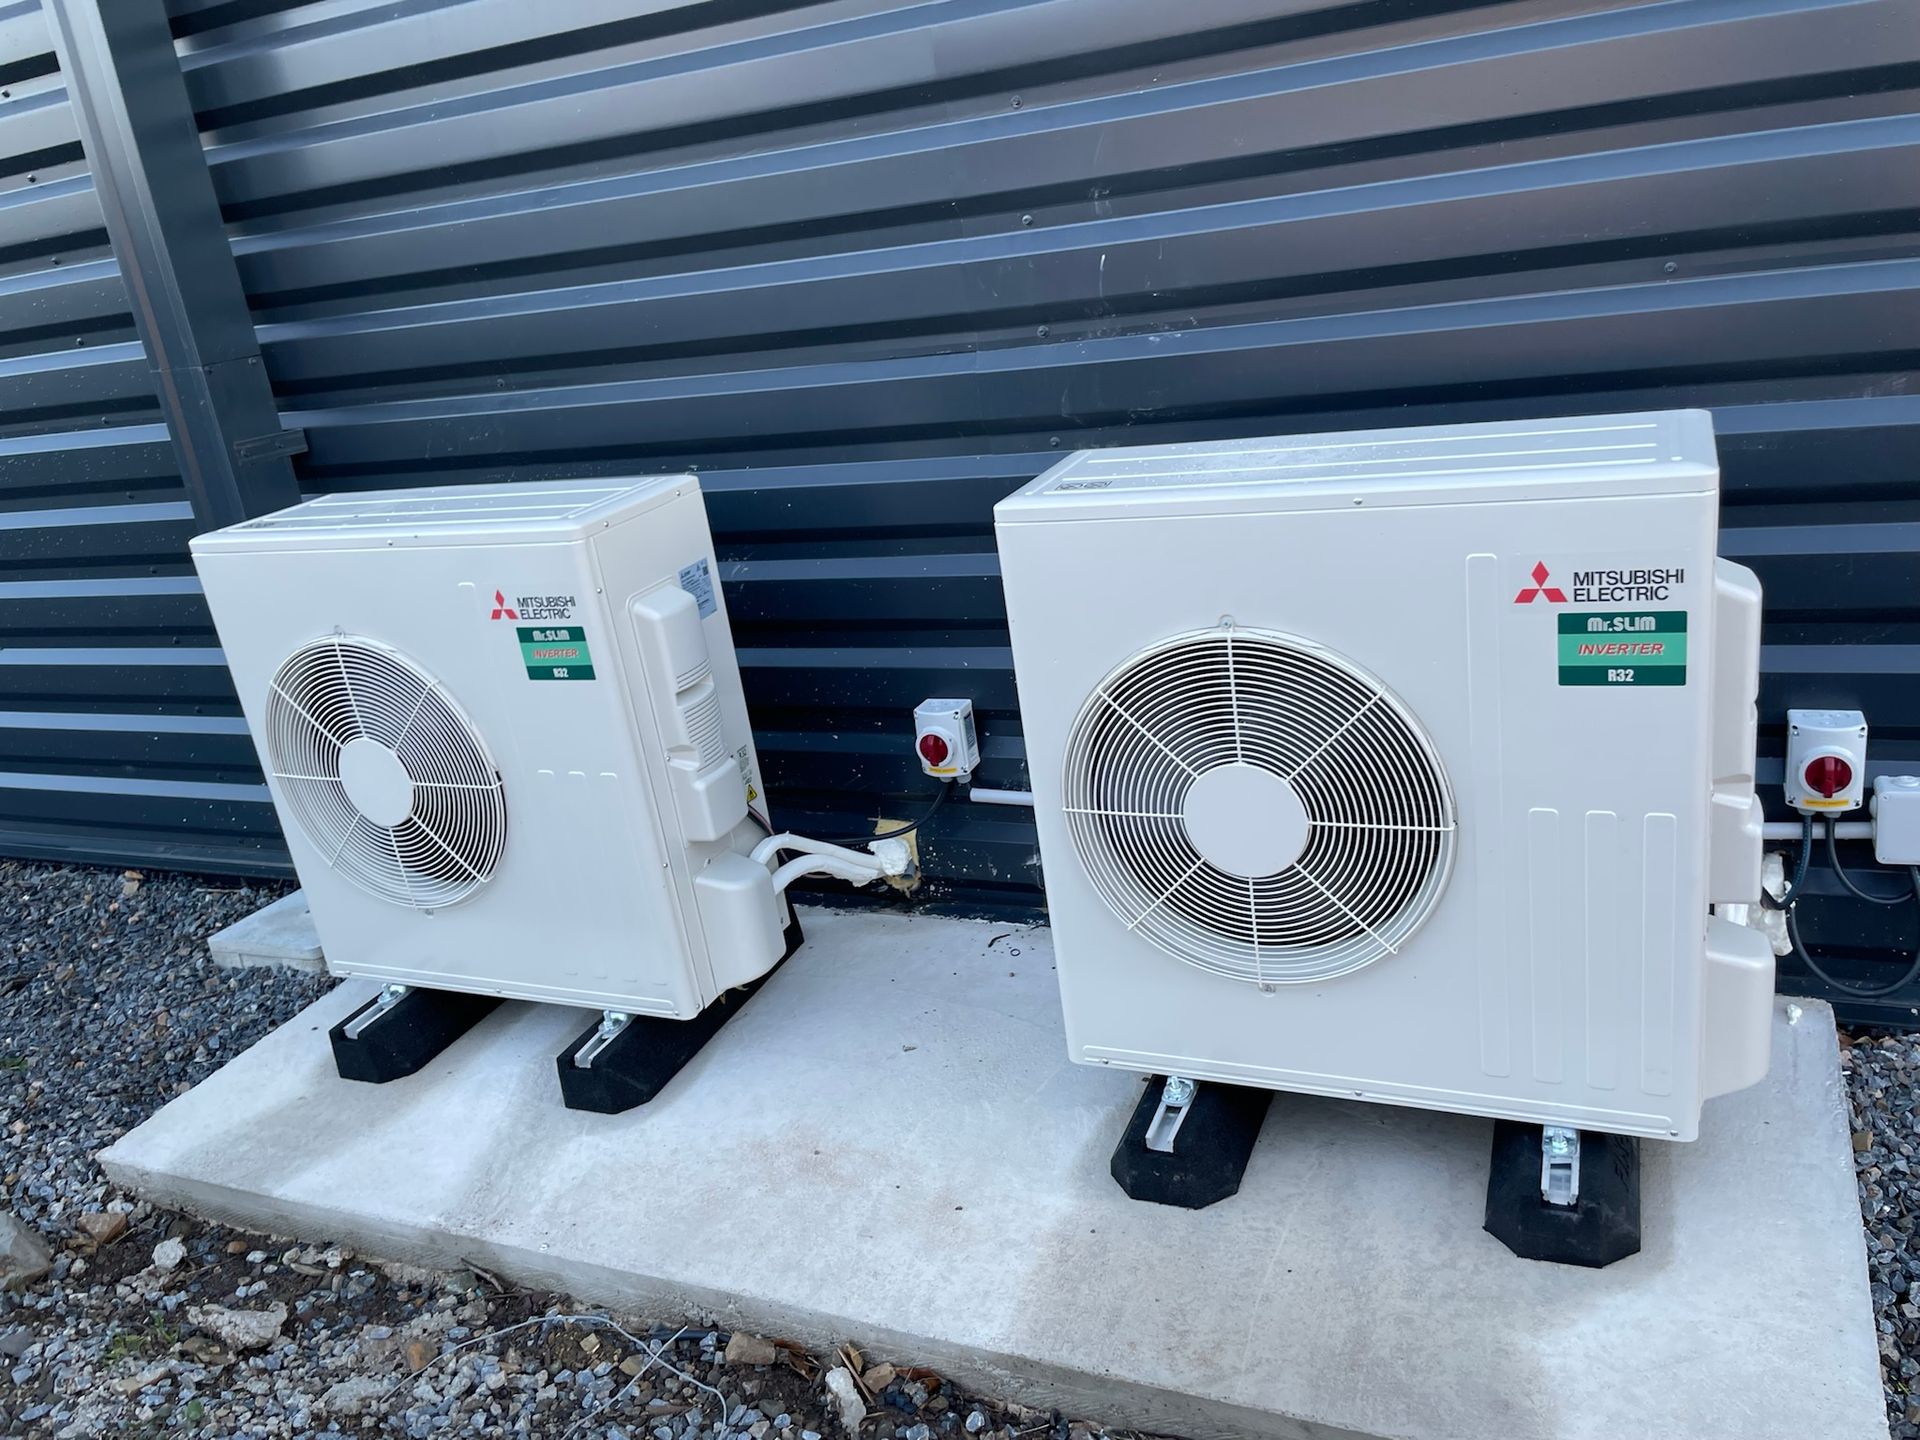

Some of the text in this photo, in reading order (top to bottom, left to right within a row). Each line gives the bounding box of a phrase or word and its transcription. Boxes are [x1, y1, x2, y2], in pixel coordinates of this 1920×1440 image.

[1573, 569, 1684, 586] MITSUBISHI
[1573, 586, 1669, 602] ELECTRIC
[517, 596, 576, 608] MITSUBISHI
[520, 608, 571, 620] ELECTRIC
[533, 648, 579, 659] INVERTER
[1578, 643, 1664, 656] INVERTER
[552, 668, 569, 678] R32
[1607, 669, 1634, 682] R32
